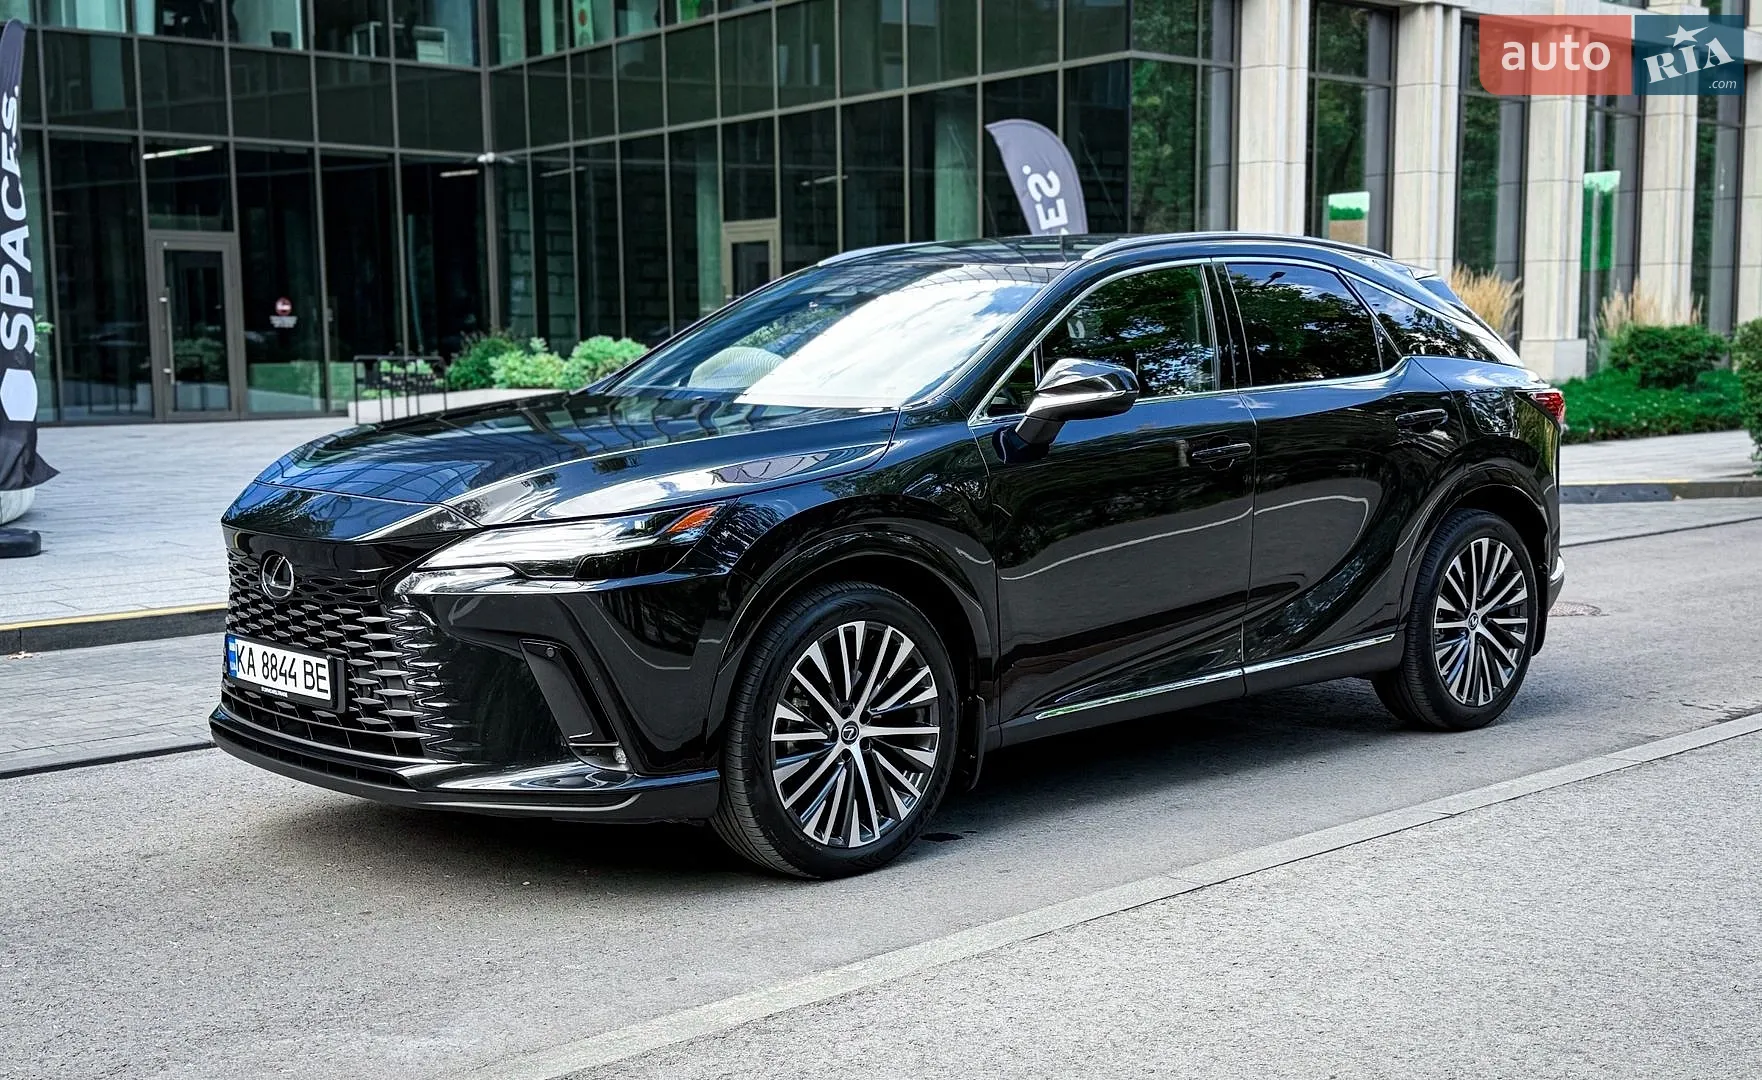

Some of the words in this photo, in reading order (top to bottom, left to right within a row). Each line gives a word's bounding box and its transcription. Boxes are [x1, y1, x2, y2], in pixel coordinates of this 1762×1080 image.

[236, 643, 256, 677] KA
[261, 651, 297, 687] 8844
[303, 660, 329, 694] BE
